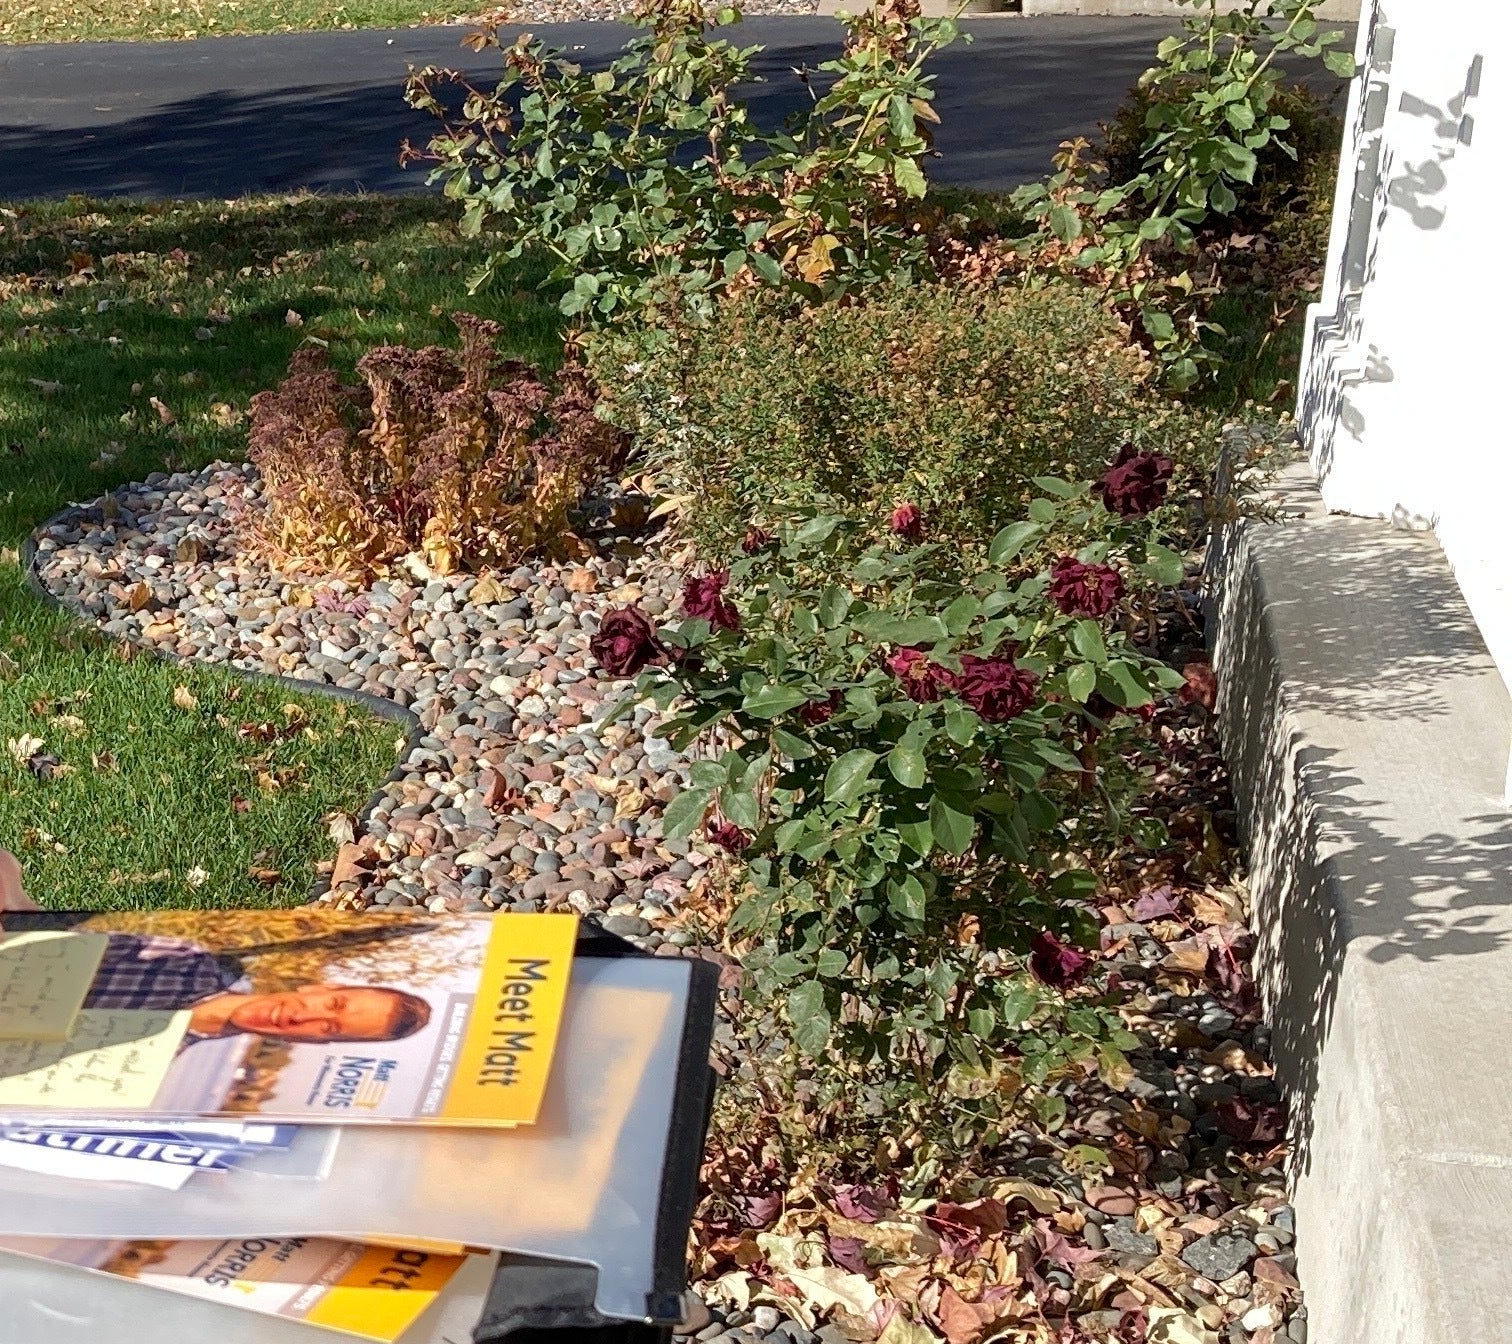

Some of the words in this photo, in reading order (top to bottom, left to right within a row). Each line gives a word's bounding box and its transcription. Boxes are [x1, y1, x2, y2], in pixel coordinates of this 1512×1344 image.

[494, 959, 551, 1022] Meet
[324, 1056, 376, 1106] NORRIS
[374, 1060, 397, 1081] Matt
[476, 1031, 536, 1086] Matt
[369, 1250, 428, 1290] att
